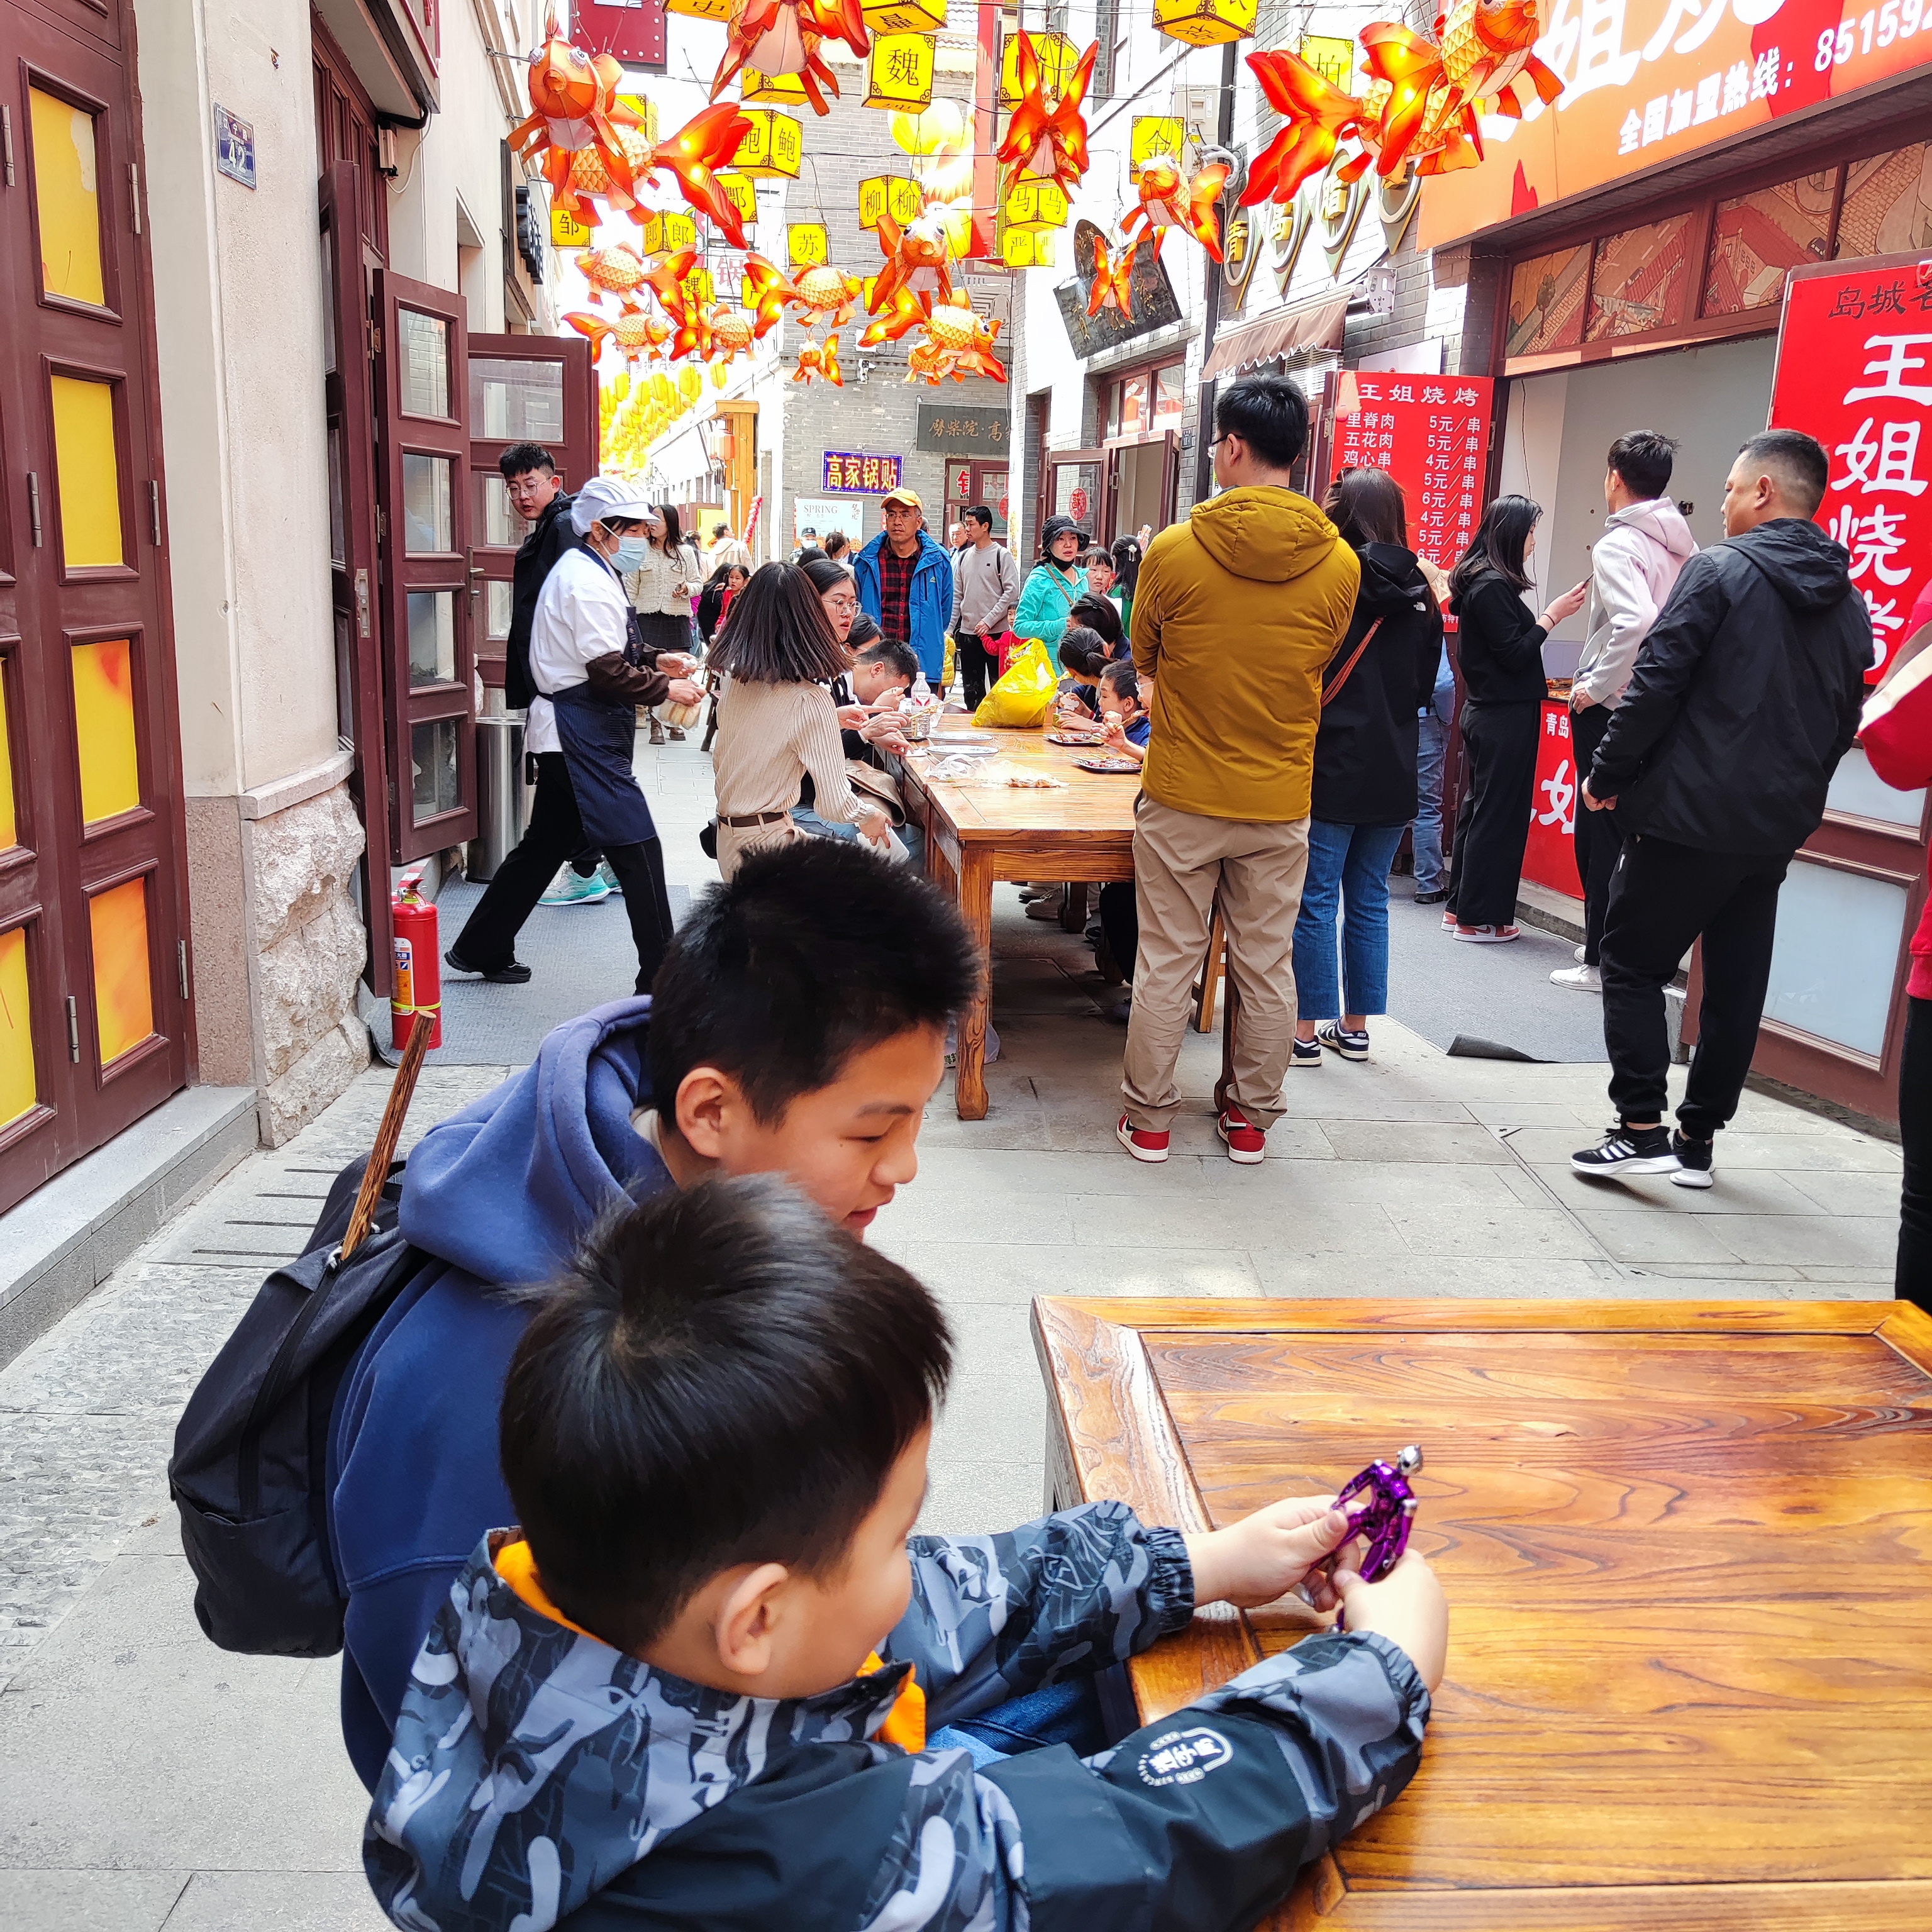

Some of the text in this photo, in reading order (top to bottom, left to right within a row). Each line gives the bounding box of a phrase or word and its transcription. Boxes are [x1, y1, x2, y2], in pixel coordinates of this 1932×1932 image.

[886, 48, 920, 87] 魏
[778, 128, 796, 162] 鲍
[229, 140, 246, 174] 42
[864, 189, 916, 218] 柳 柳
[1014, 187, 1062, 215] 马 马
[560, 214, 579, 236] 邹
[646, 222, 689, 245] 郎 郎
[797, 234, 818, 256] 苏
[1010, 236, 1028, 258] 严
[1358, 384, 1480, 407] 王姐烧烤
[1346, 411, 1480, 434] 里脊肉 5元/串
[1344, 431, 1479, 453] 五花肉 5元/串
[1342, 450, 1477, 472] 鸡心串 4元/串
[826, 456, 897, 490] 高家锅贴
[1424, 473, 1475, 491] 5元/串
[804, 504, 838, 514] SPRING
[1422, 491, 1474, 509] 6元/串
[1420, 510, 1472, 529] 4元/串
[1418, 530, 1469, 547] 5元/串
[1545, 713, 1569, 739] 青岛
